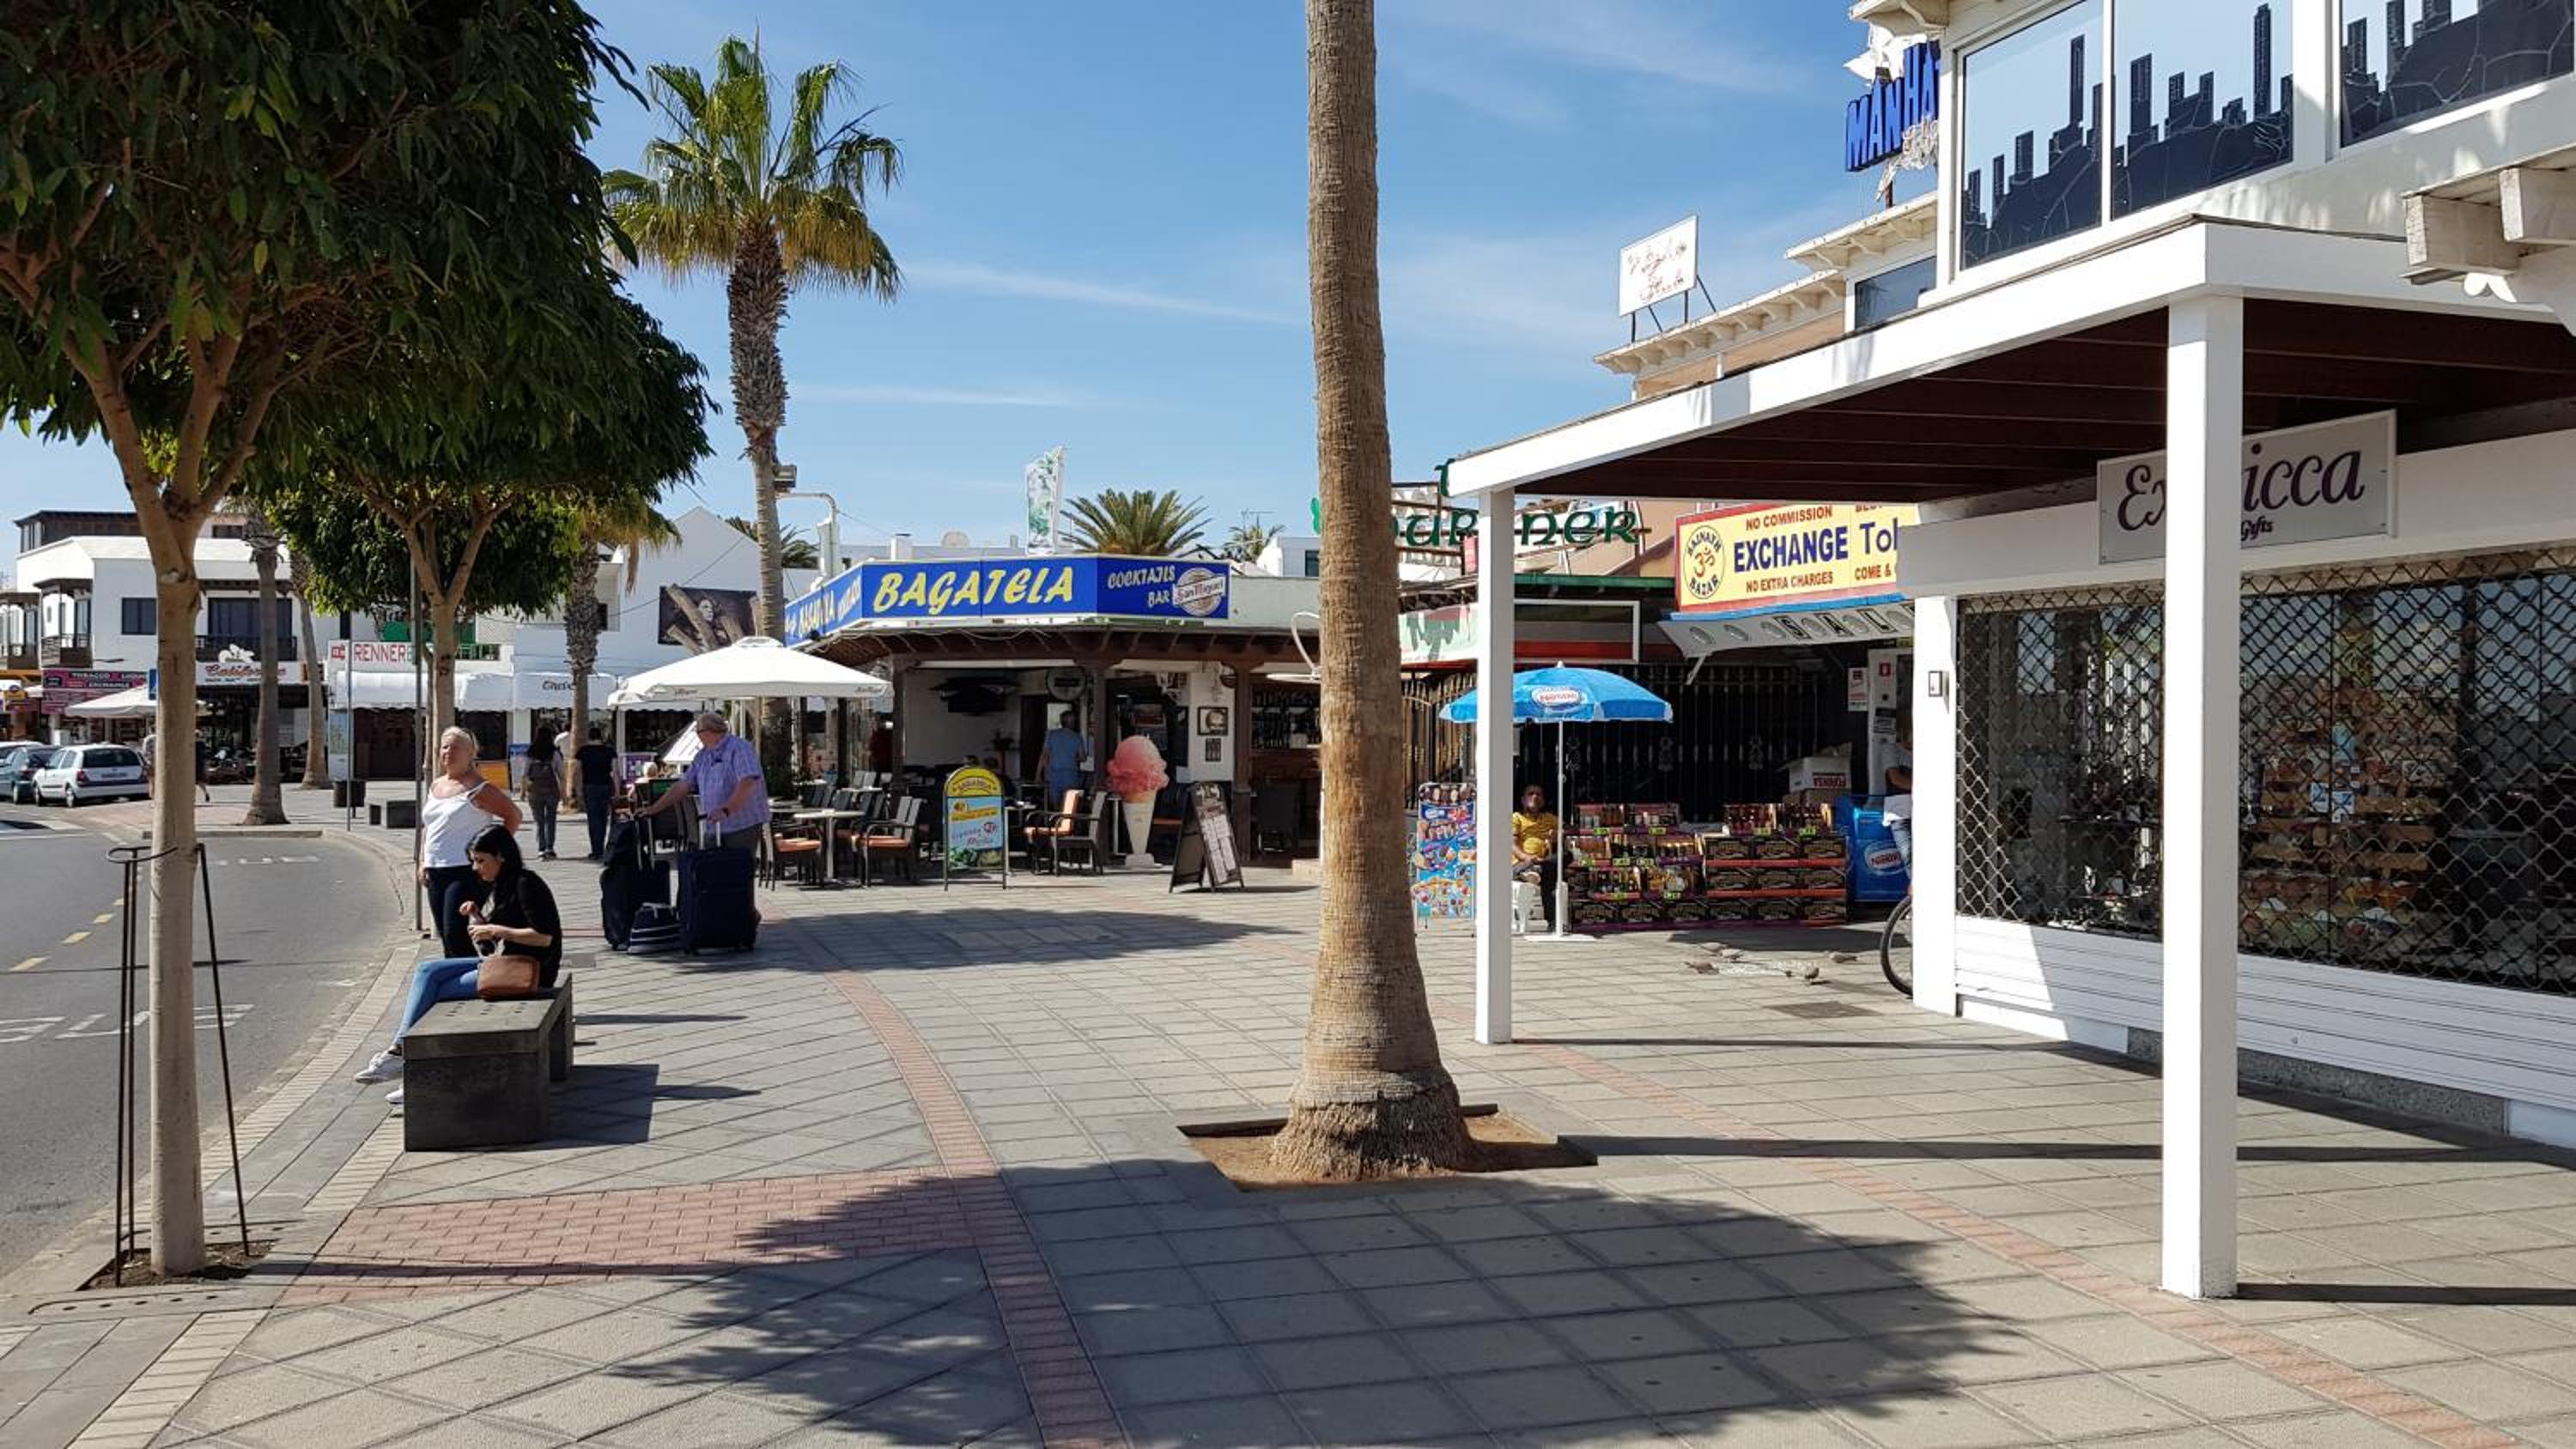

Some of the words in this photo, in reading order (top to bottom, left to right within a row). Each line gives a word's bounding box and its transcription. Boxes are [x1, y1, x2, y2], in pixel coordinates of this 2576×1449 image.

[1847, 40, 1941, 172] MANHA
[1746, 518, 1760, 531] NO
[1763, 502, 1833, 526] COMMISSION
[1734, 525, 1848, 573] EXCHANGE
[872, 566, 1073, 616] BAGATELA
[1106, 565, 1176, 590] COCKTAILS
[1746, 581, 1759, 593] NO
[1760, 579, 1789, 591] EXTRA
[1790, 571, 1833, 588] CHARGES
[1147, 590, 1170, 608] BAR
